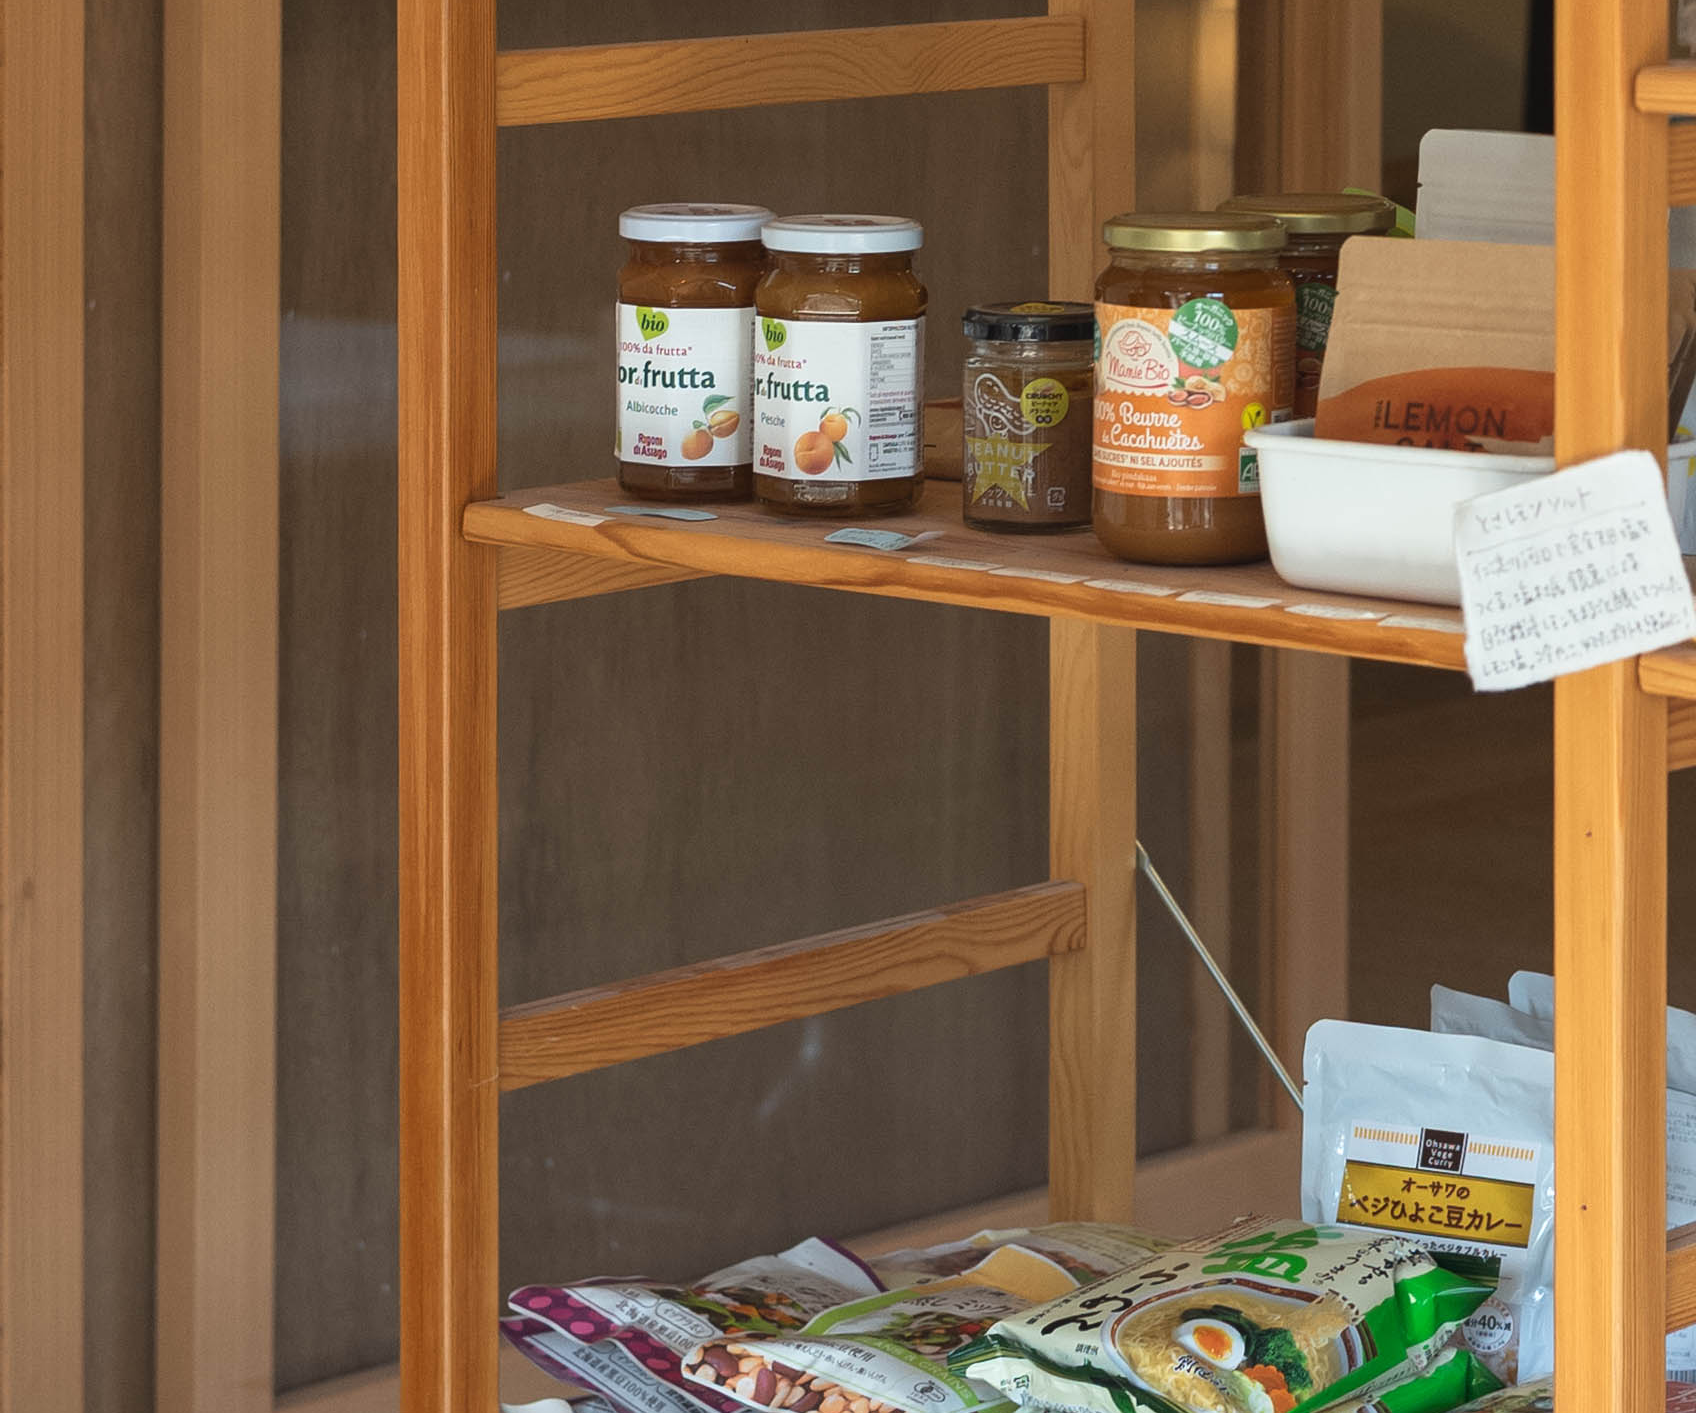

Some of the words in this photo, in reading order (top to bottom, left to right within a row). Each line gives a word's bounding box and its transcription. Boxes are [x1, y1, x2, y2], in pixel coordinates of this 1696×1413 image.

[641, 314, 665, 333] bio
[765, 328, 784, 345] bio
[642, 345, 654, 354] da
[767, 355, 776, 366] da
[1105, 351, 1143, 380] Mamie
[1144, 358, 1170, 381] Bio
[643, 361, 716, 389] frutta
[767, 372, 830, 403] frutta
[626, 398, 679, 416] Albicocche
[1119, 402, 1182, 428] Beurre
[761, 412, 786, 428] Pesche
[1383, 400, 1507, 437] LEMON
[638, 433, 663, 448] Rigoni
[633, 445, 641, 455] di
[641, 444, 668, 460] Asiago
[763, 445, 782, 457] Rigoni
[966, 442, 1034, 464] PEANUT
[767, 457, 785, 473] Asiago
[1129, 452, 1139, 463] NI
[1141, 453, 1157, 466] SEL
[1159, 454, 1203, 468] AJOUTÉS
[967, 461, 1036, 482] BUTTER
[1425, 1138, 1462, 1152] Ohsawa
[1428, 1155, 1455, 1169] Curry
[1431, 1148, 1454, 1160] Vege
[1401, 1177, 1471, 1200] オーサワの
[1350, 1194, 1522, 1232] ベジひよこ豆カレー
[917, 1360, 971, 1401] GRAINS
